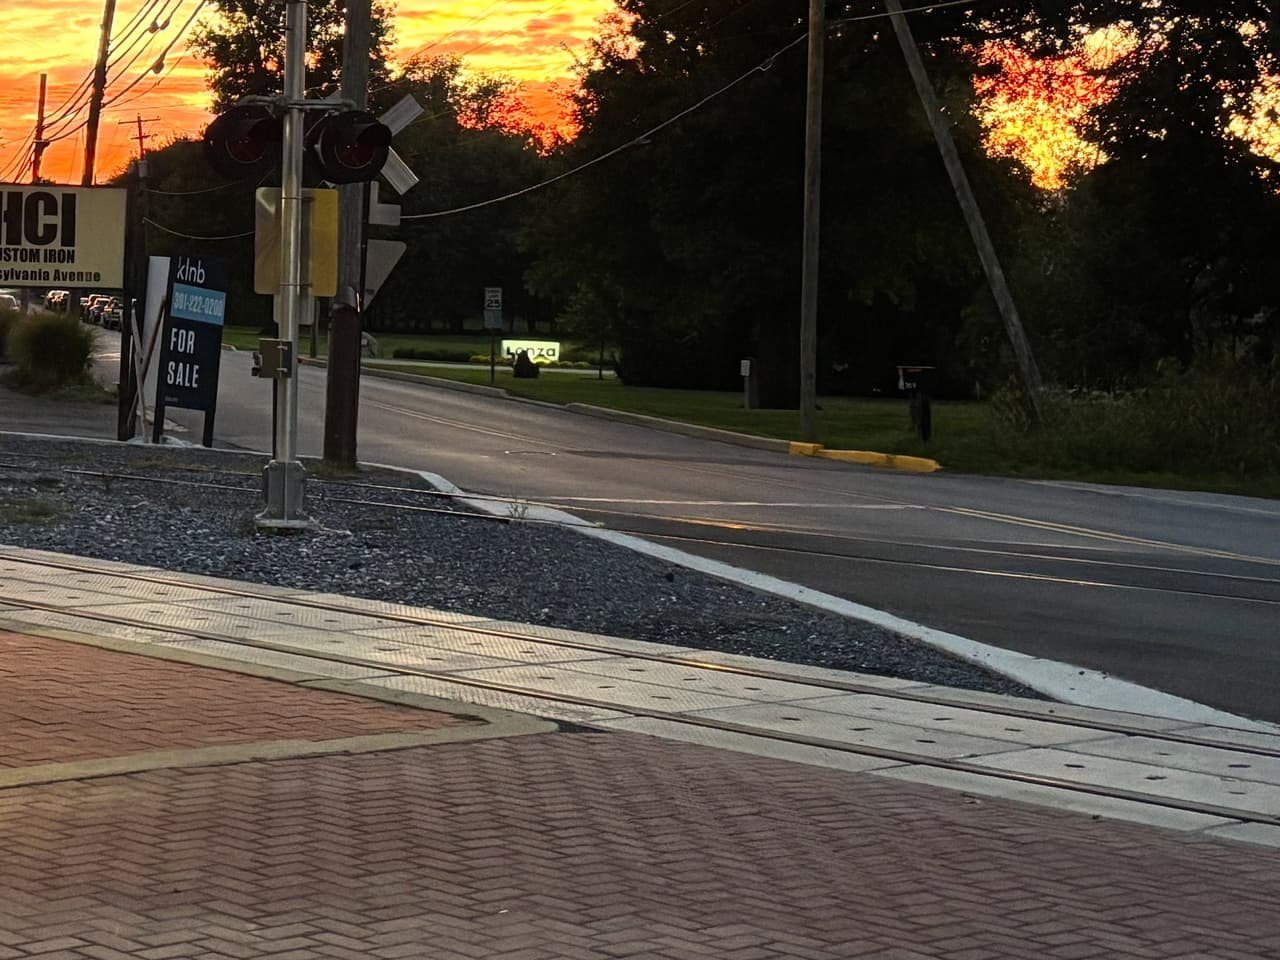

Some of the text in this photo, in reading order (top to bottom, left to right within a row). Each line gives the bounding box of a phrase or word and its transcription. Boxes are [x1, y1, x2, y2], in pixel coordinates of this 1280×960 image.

[43, 248, 76, 264] IRON
[53, 268, 101, 282] Avenue
[176, 256, 206, 284] klnb
[487, 299, 501, 308] 25
[170, 328, 195, 354] FOR
[167, 361, 200, 388] SALE
